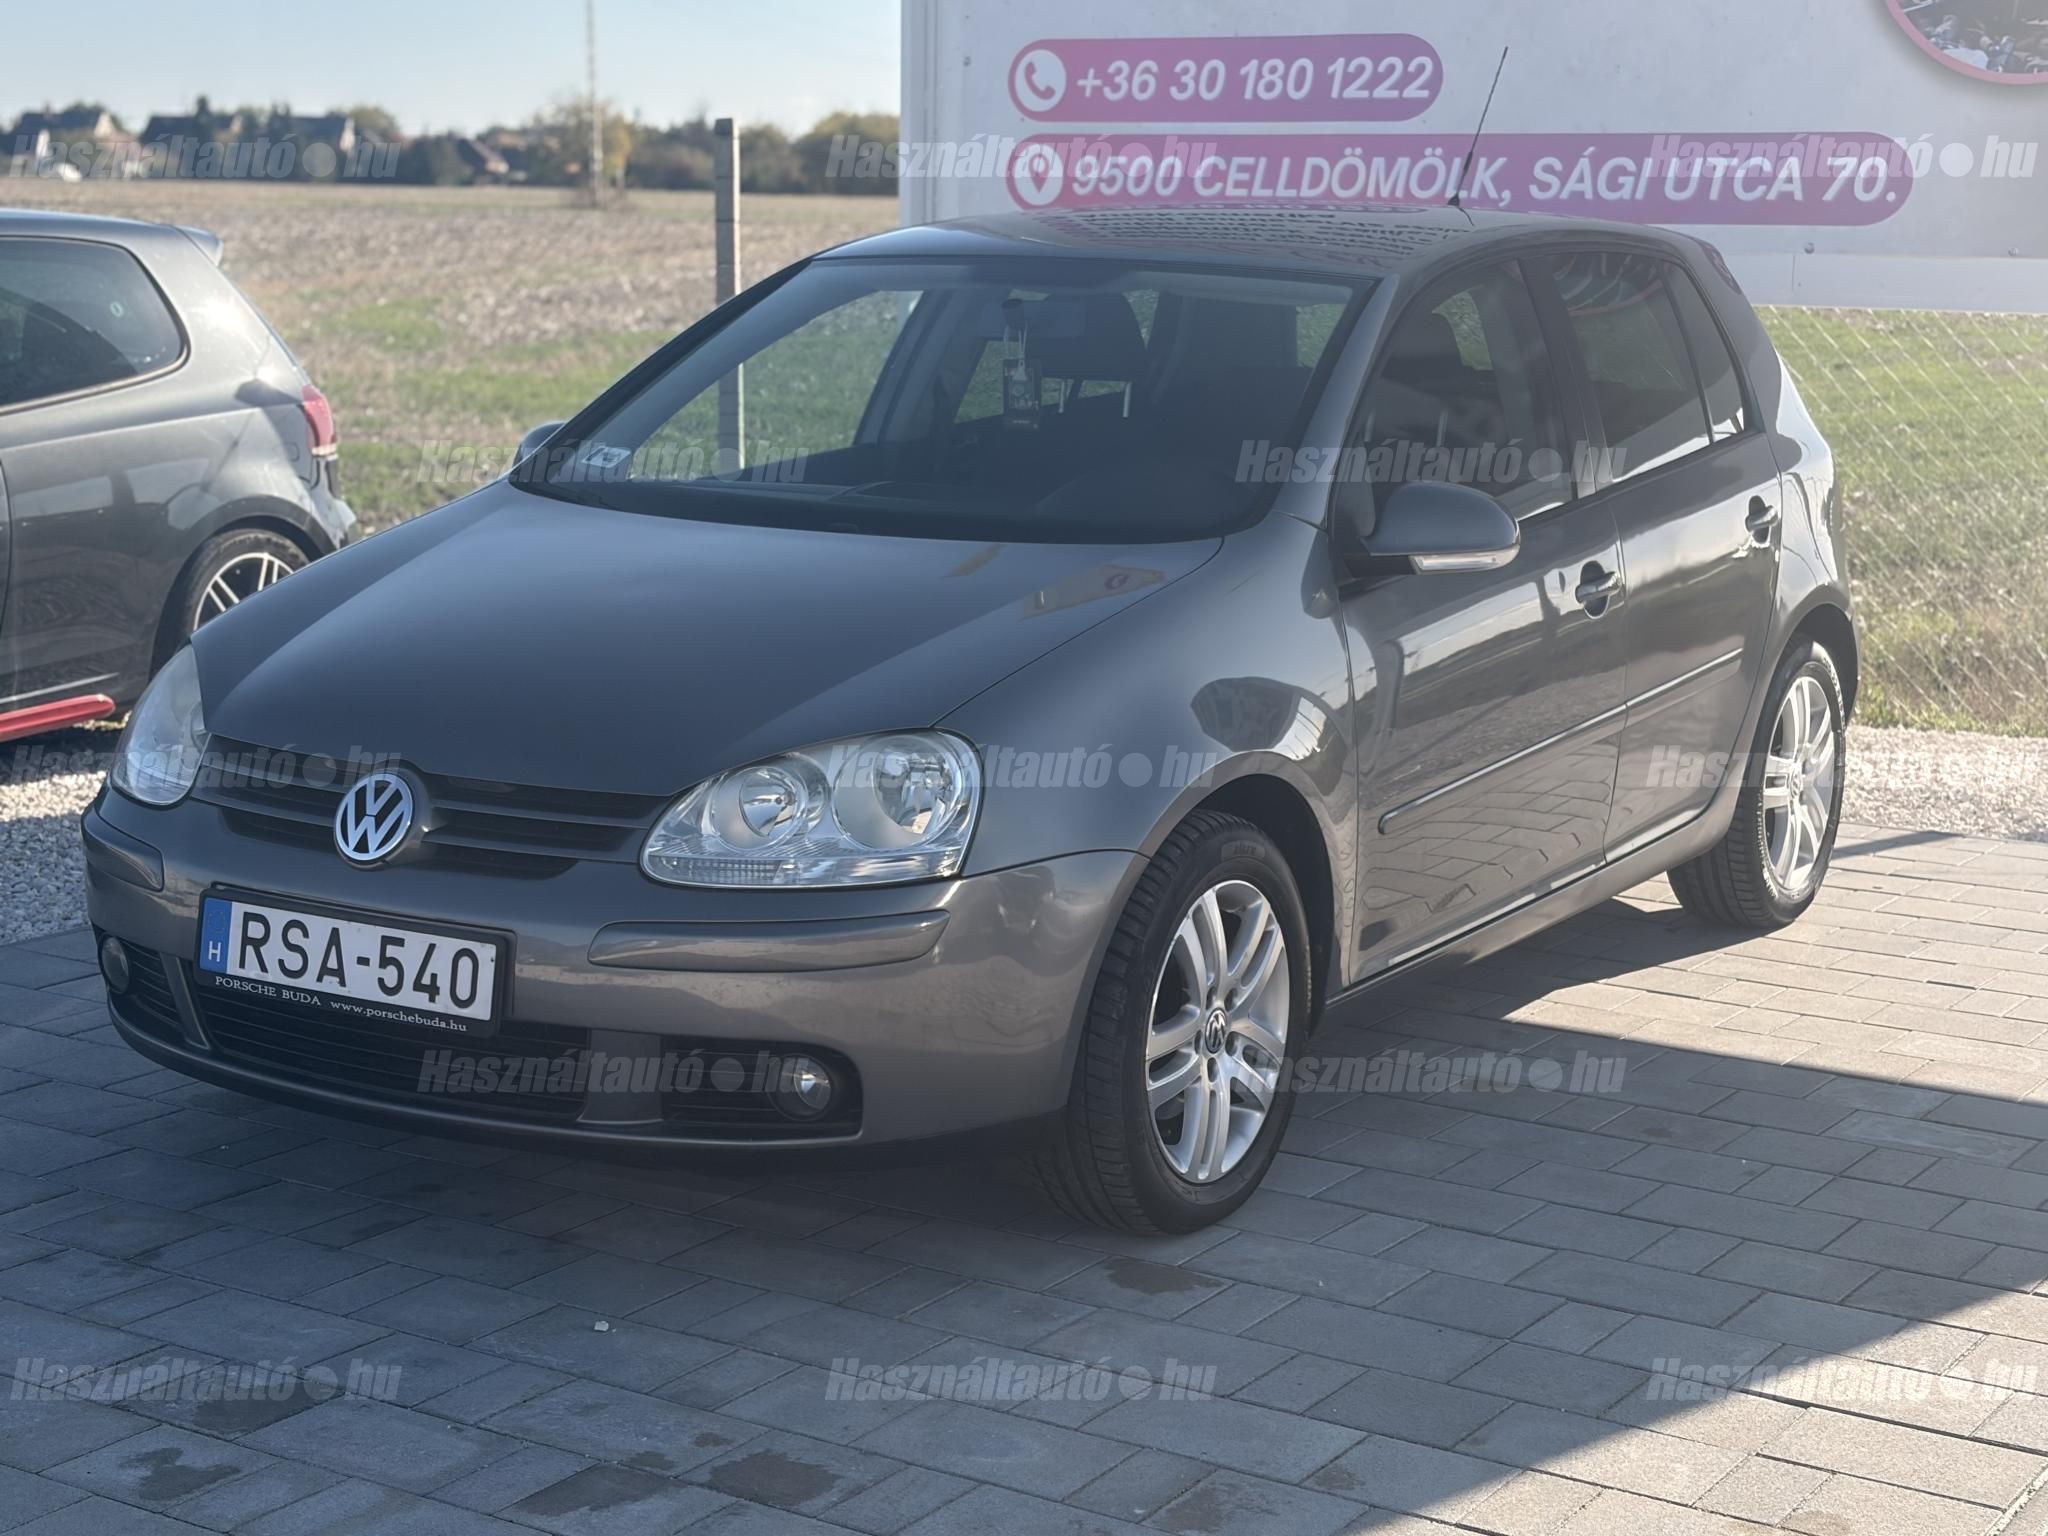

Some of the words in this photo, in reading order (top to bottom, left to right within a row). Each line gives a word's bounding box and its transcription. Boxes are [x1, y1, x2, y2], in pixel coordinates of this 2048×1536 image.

[1077, 58, 1159, 101] +36
[1169, 58, 1225, 101] 30
[1239, 57, 1314, 100] 180
[1327, 55, 1435, 99] 1222
[1072, 155, 1182, 197] 9500
[1193, 146, 1512, 207] CELLDÖMÖLK,
[1528, 147, 1648, 200] SÁGI
[1661, 155, 1803, 201] UTCA
[1821, 155, 1898, 202] 70.
[208, 940, 221, 962] H
[238, 911, 480, 1009] RSA-540
[215, 976, 277, 997] PORSCHE
[281, 990, 321, 1006] BUDA
[330, 1000, 467, 1032] www.porschebuda.hu
